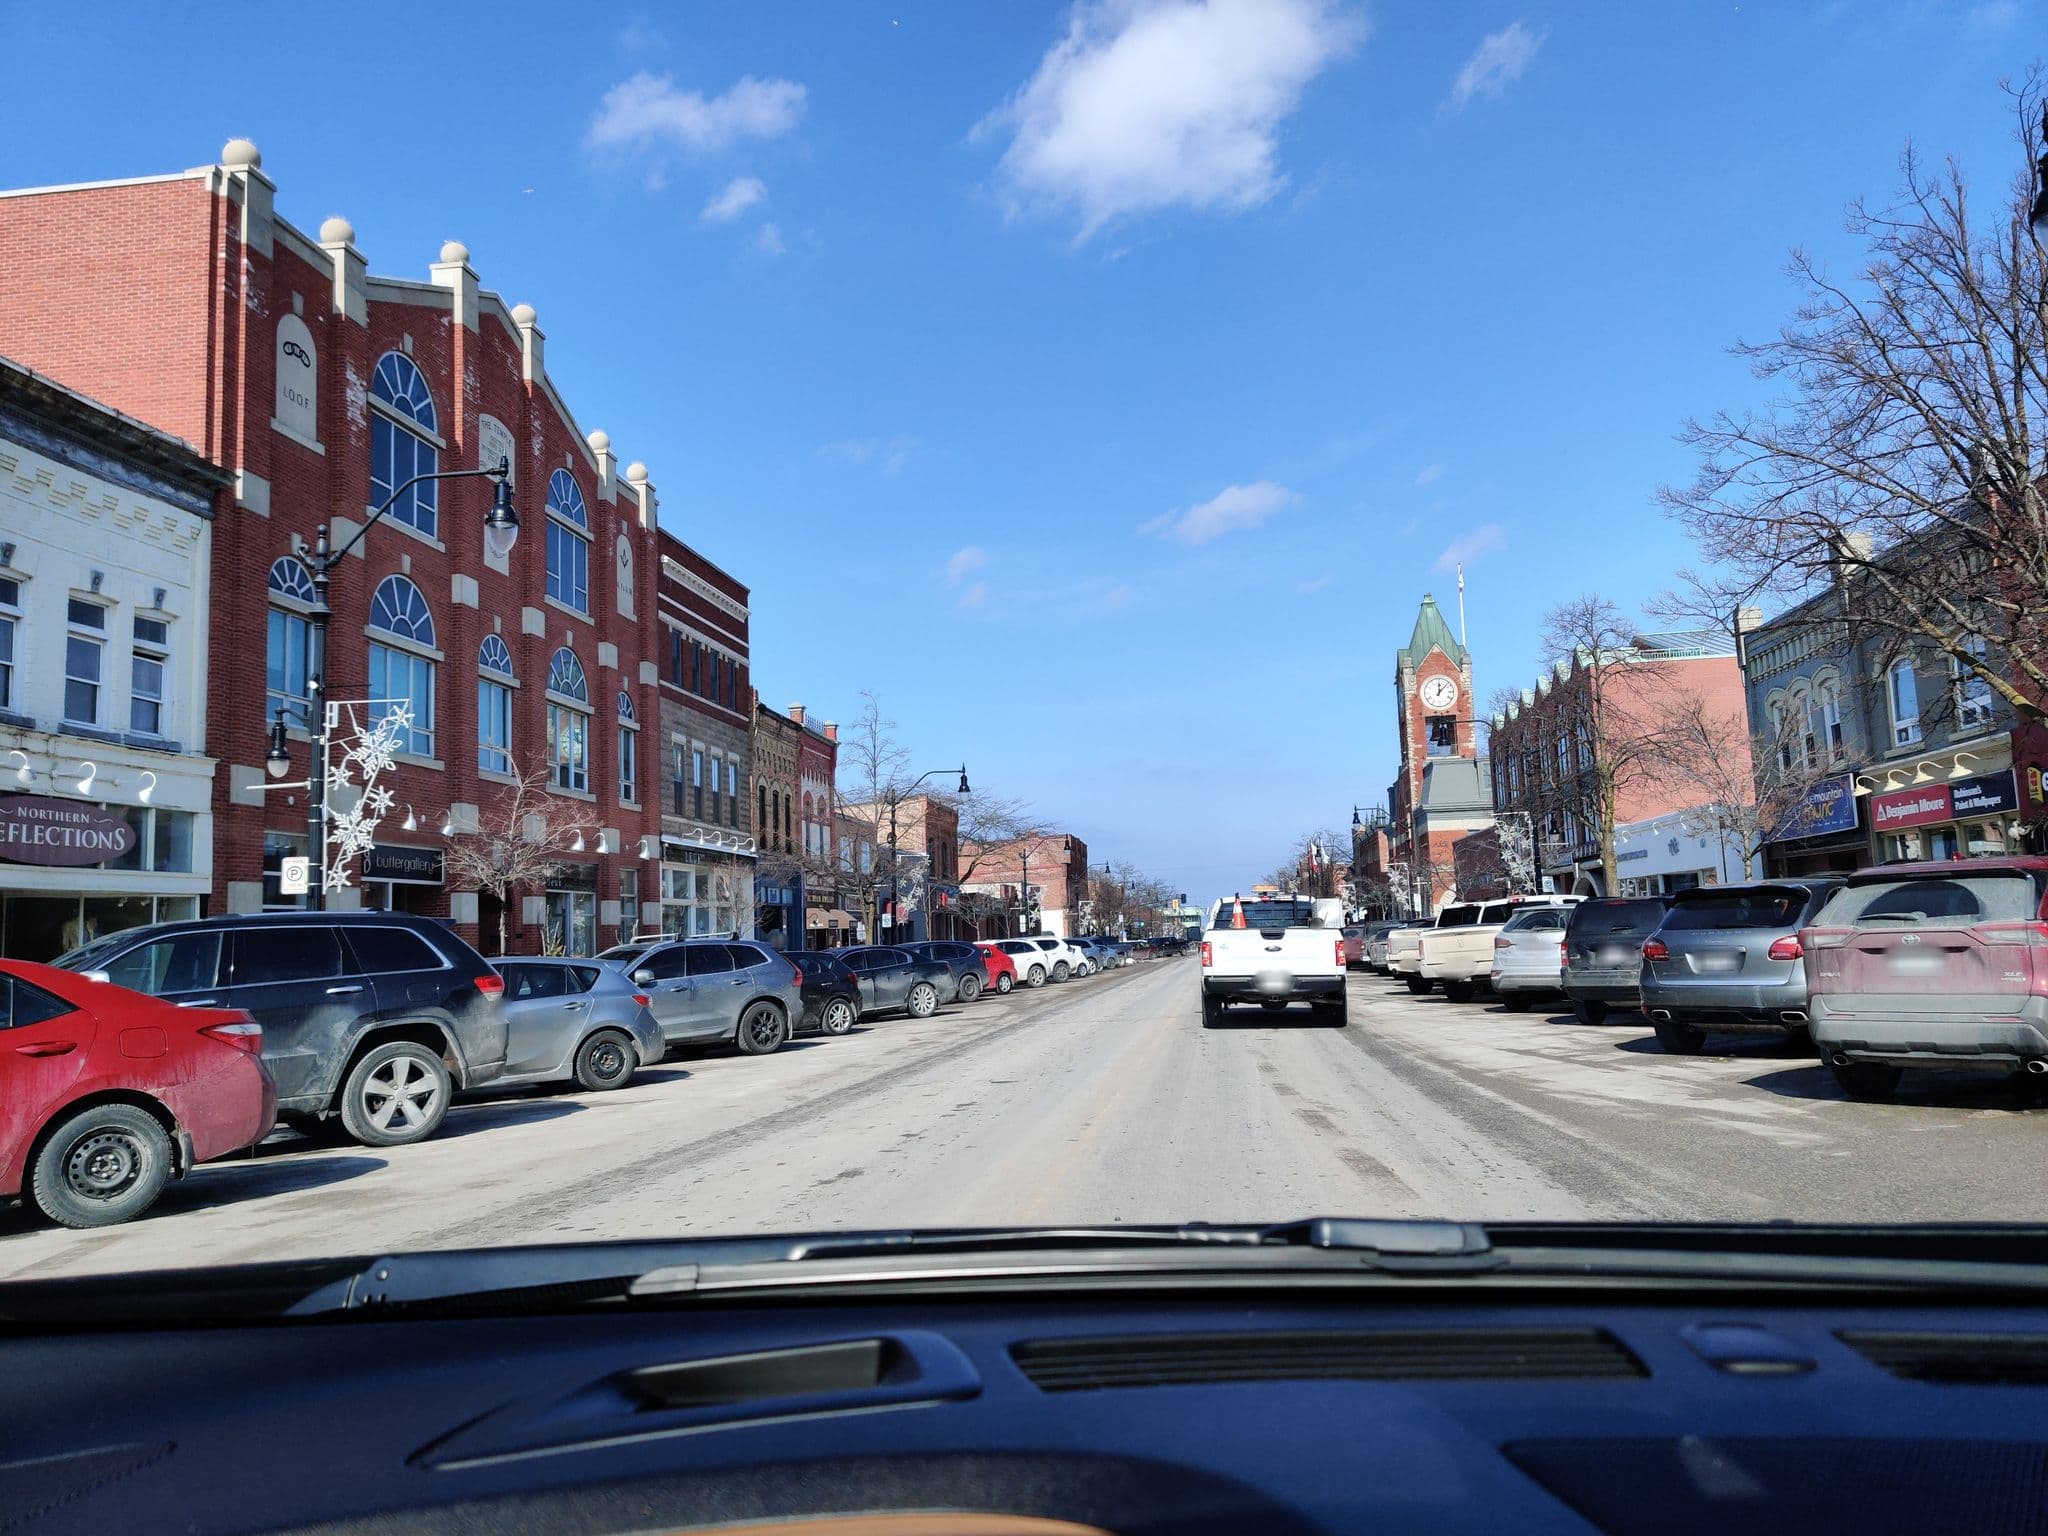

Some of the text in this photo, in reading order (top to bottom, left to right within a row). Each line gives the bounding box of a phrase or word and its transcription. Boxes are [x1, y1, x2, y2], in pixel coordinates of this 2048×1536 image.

[17, 806, 90, 824] NORTHERN
[1885, 798, 1945, 820] Benjamin Moore
